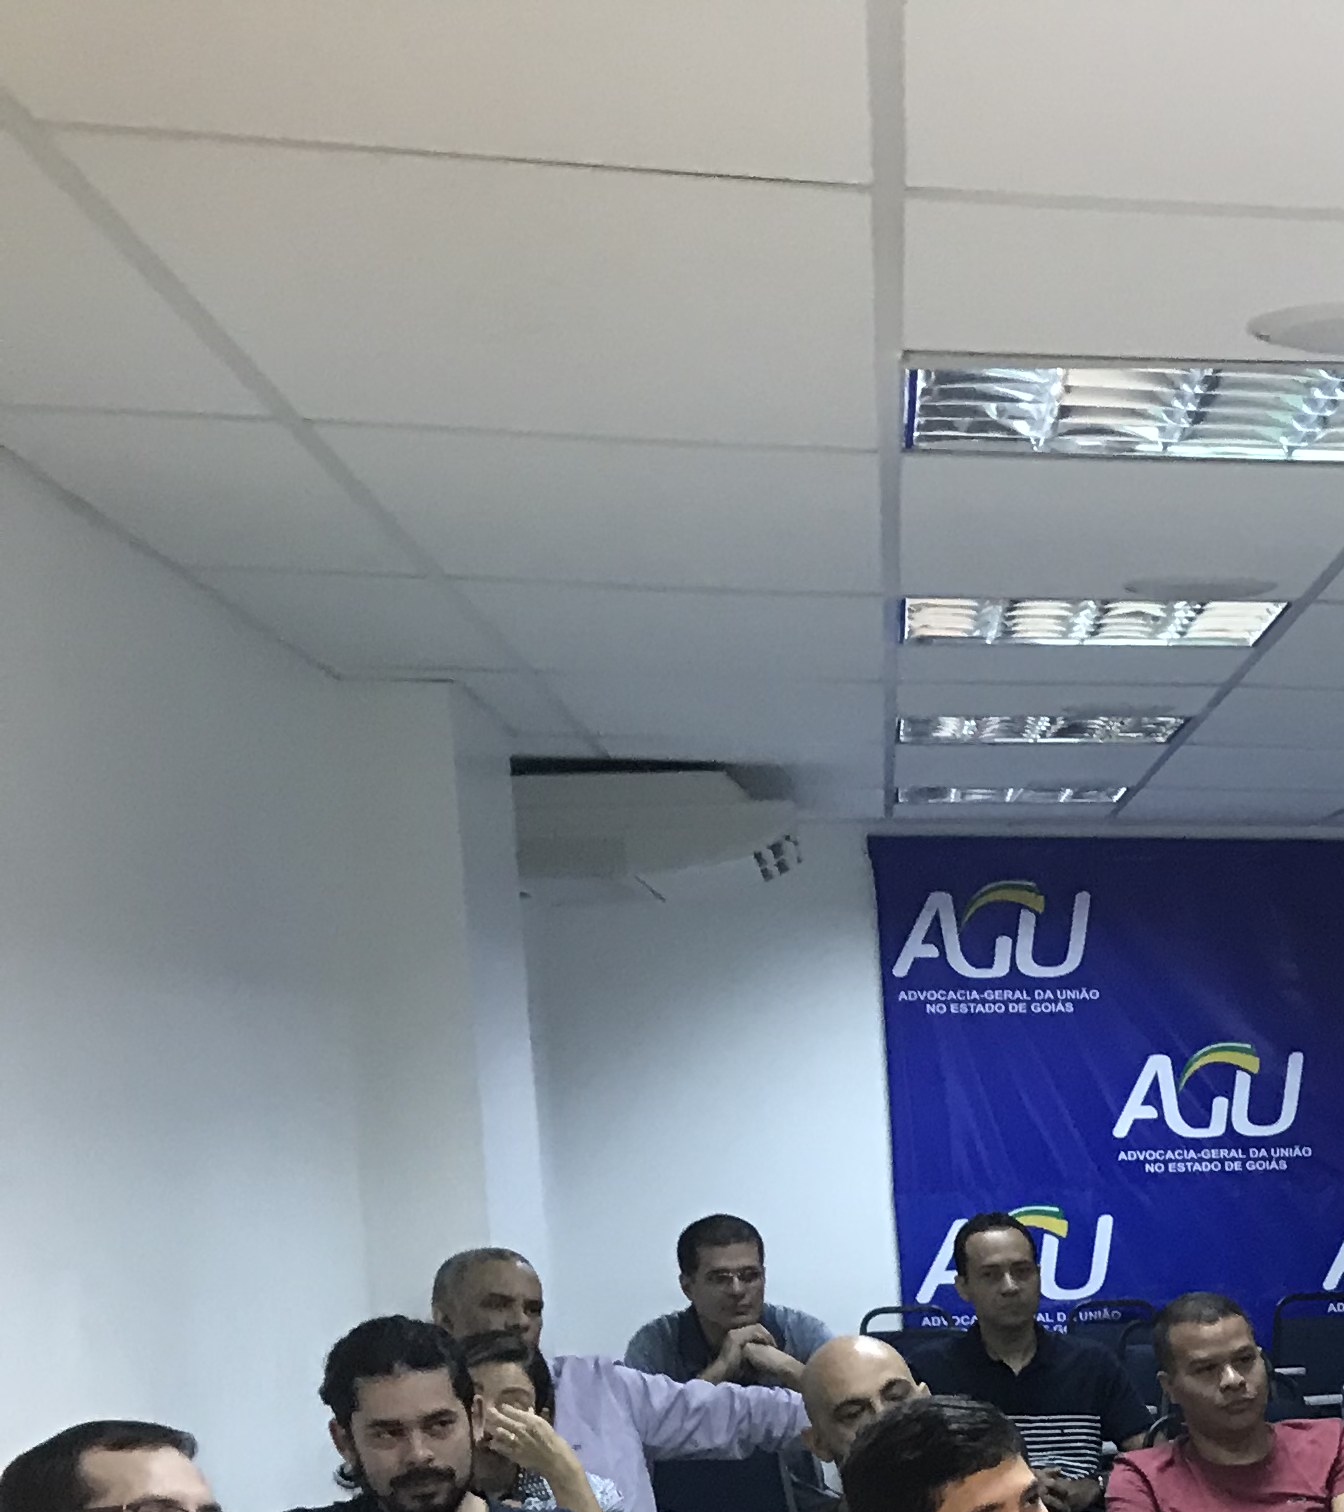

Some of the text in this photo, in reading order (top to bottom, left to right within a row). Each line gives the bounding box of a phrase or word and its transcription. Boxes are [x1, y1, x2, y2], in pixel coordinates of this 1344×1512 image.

[892, 880, 1090, 978] AGU
[898, 987, 1100, 1001] ADVOCACIA-GERAL DA UNIÃO
[926, 1000, 1074, 1014] NO ESTADO DE GOIÁS
[1112, 1042, 1304, 1139] AGU
[1118, 1145, 1312, 1161] ADVOCACIA-GERAL DA UNIÃO
[1145, 1158, 1287, 1173] NO ESTADO DE GOIÁS
